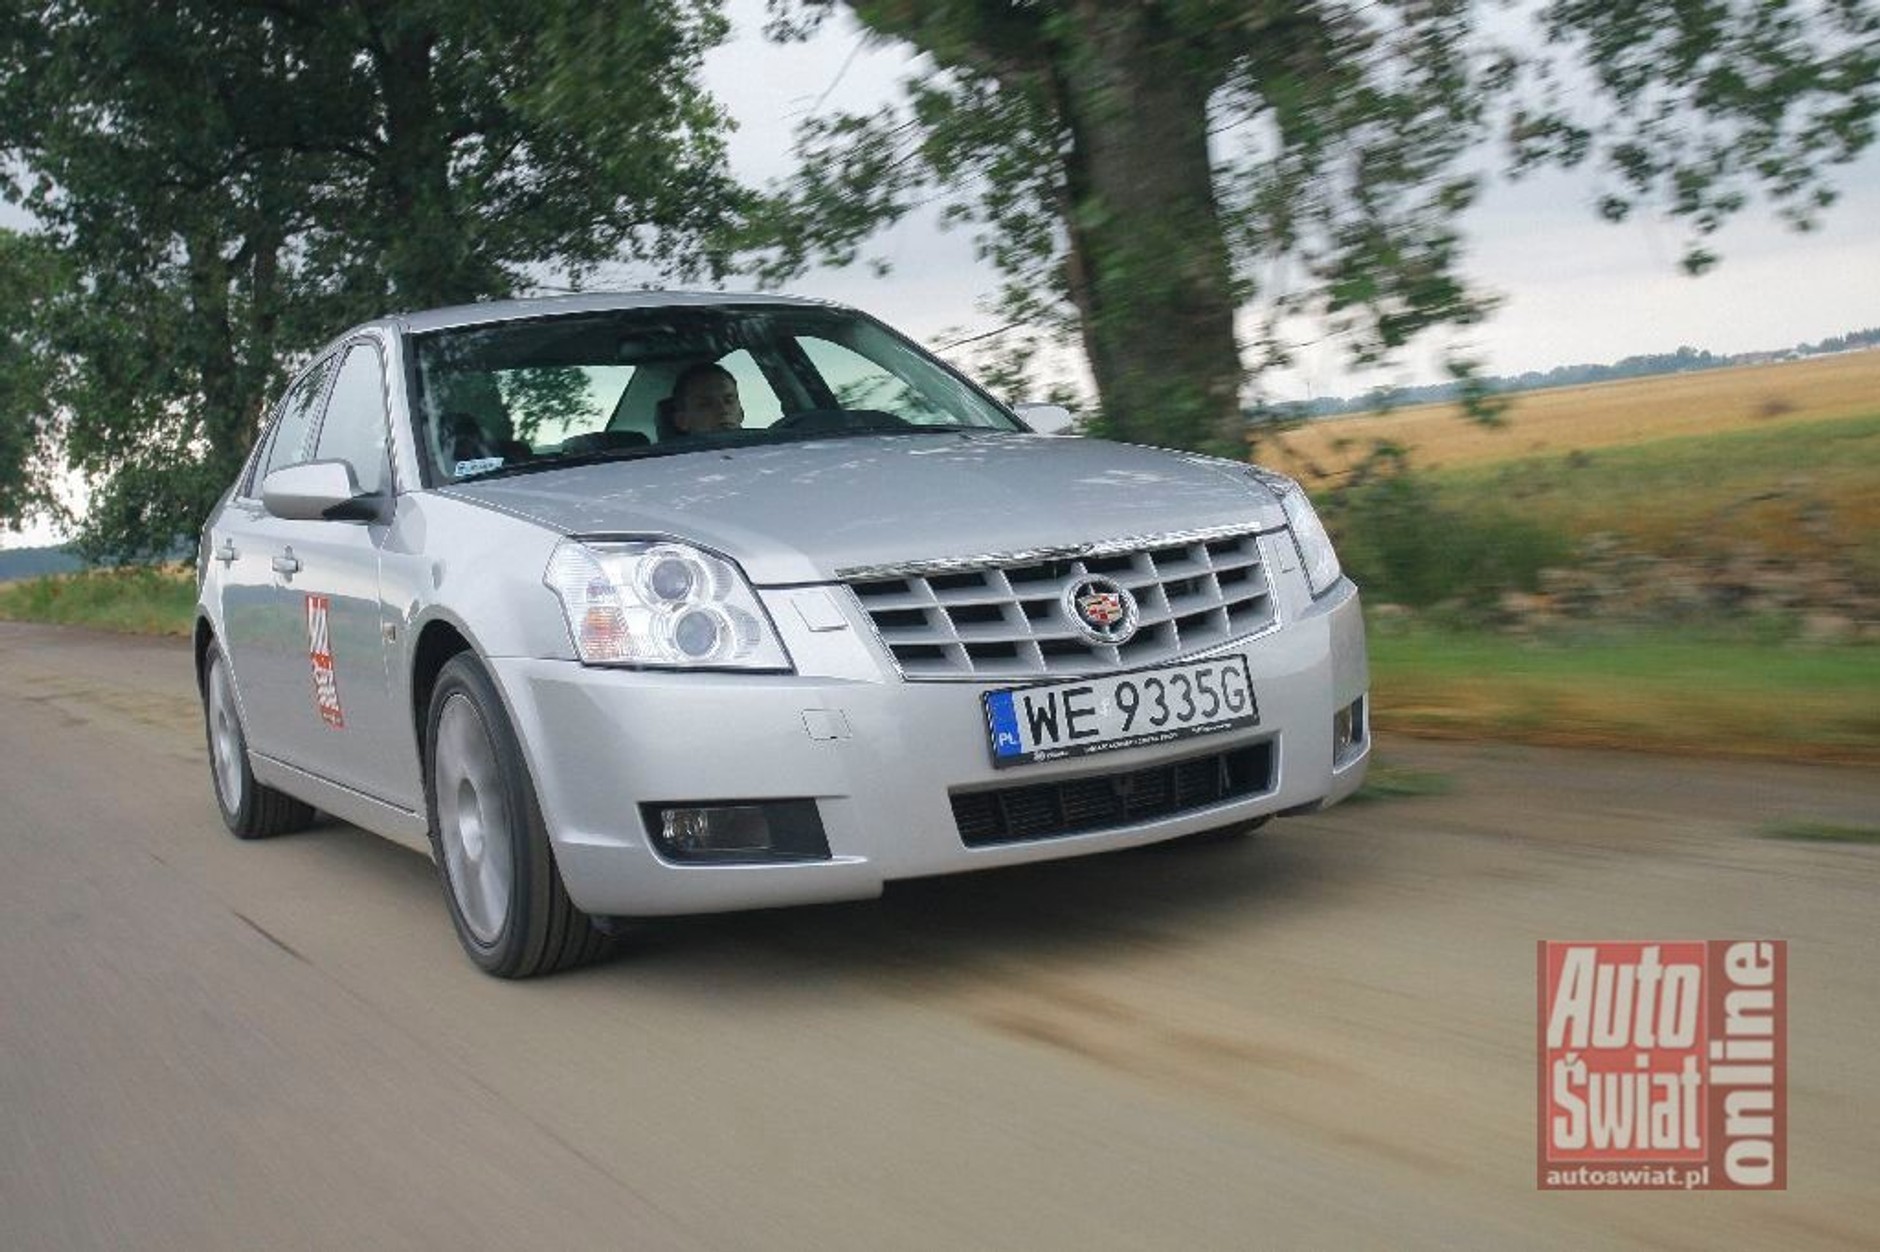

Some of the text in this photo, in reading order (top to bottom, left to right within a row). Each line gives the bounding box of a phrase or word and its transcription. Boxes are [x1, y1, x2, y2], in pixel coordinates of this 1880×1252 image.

[1023, 666, 1246, 746] WE 9335G
[999, 732, 1017, 746] PL
